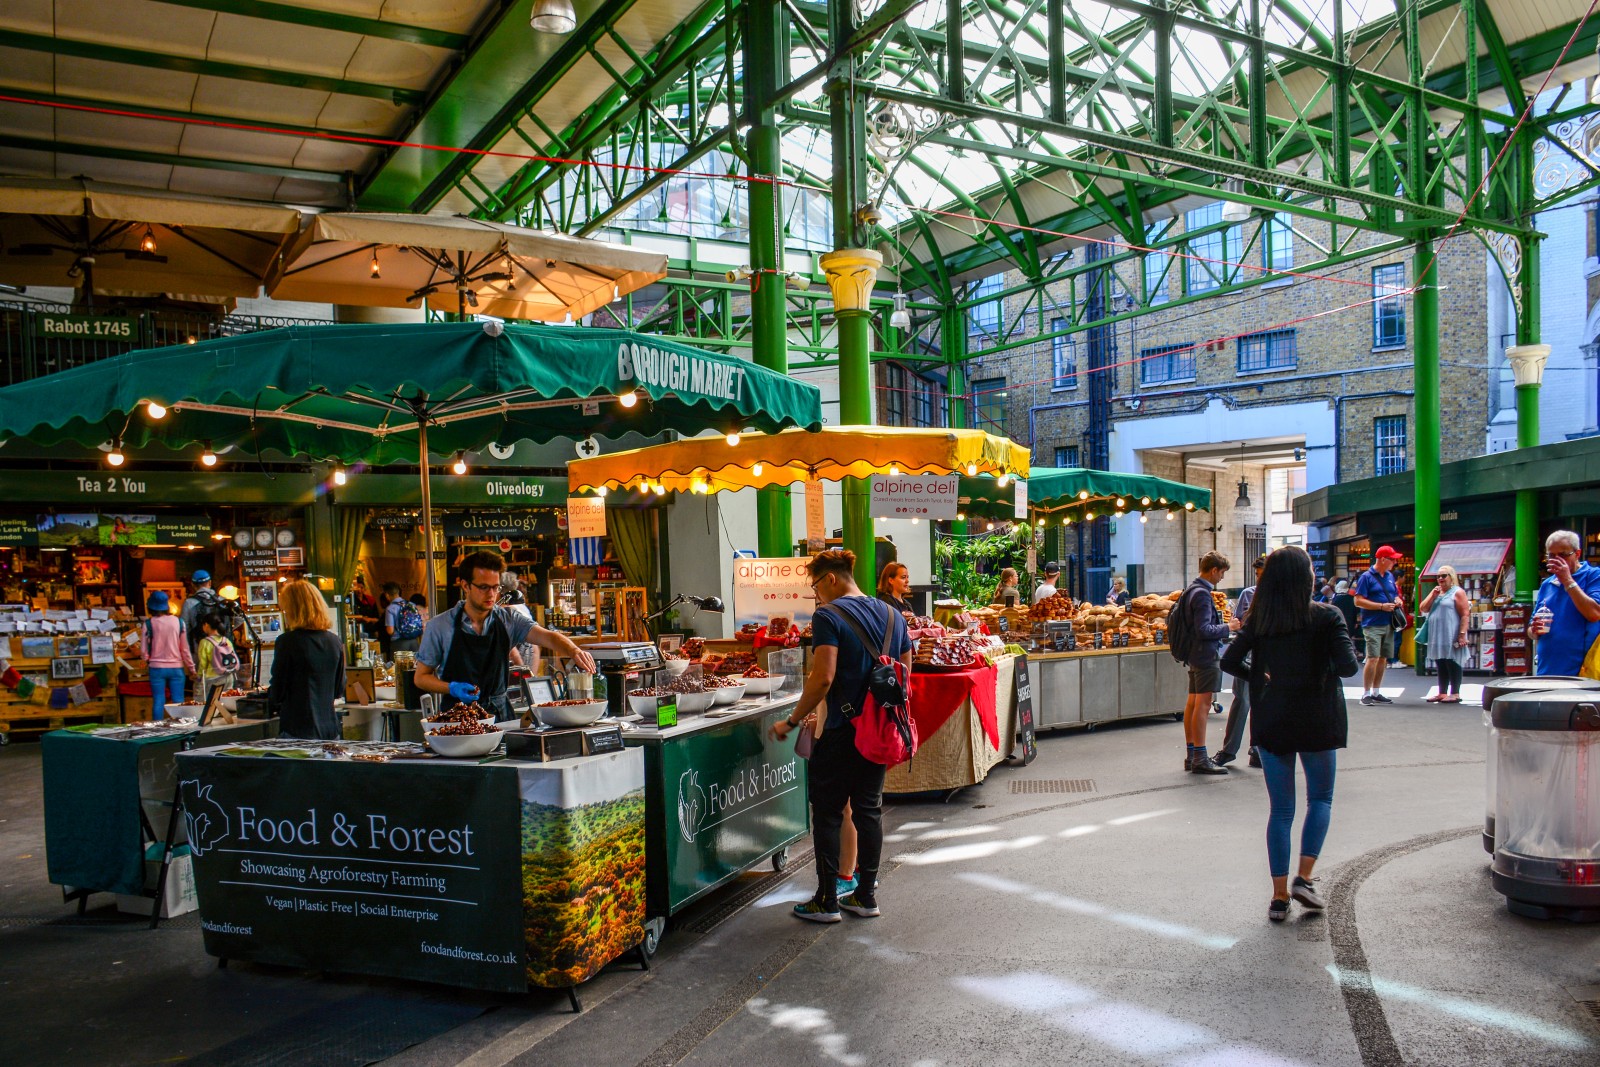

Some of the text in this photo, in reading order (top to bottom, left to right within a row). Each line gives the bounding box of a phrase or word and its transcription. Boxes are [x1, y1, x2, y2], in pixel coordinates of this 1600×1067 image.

[43, 318, 131, 336] Rabot 1745
[618, 343, 745, 402] BOROUGH MARKET
[77, 477, 146, 493] Tea 2 You
[486, 481, 545, 497] Oliveology
[873, 479, 955, 496] alpine deli
[569, 502, 591, 517] alpine
[1440, 510, 1458, 521] ountain
[376, 517, 411, 525] ORGANIC
[463, 515, 538, 531] oliveology
[738, 562, 791, 580] alpine
[710, 757, 796, 816] Food & Forest
[236, 806, 475, 856] Food & Forest
[240, 859, 446, 893] Showcasing Agroforestry Farming
[266, 896, 440, 923] Vegan Plastic Free Social Enterprise
[420, 940, 518, 965] foodandforest.co.uk
